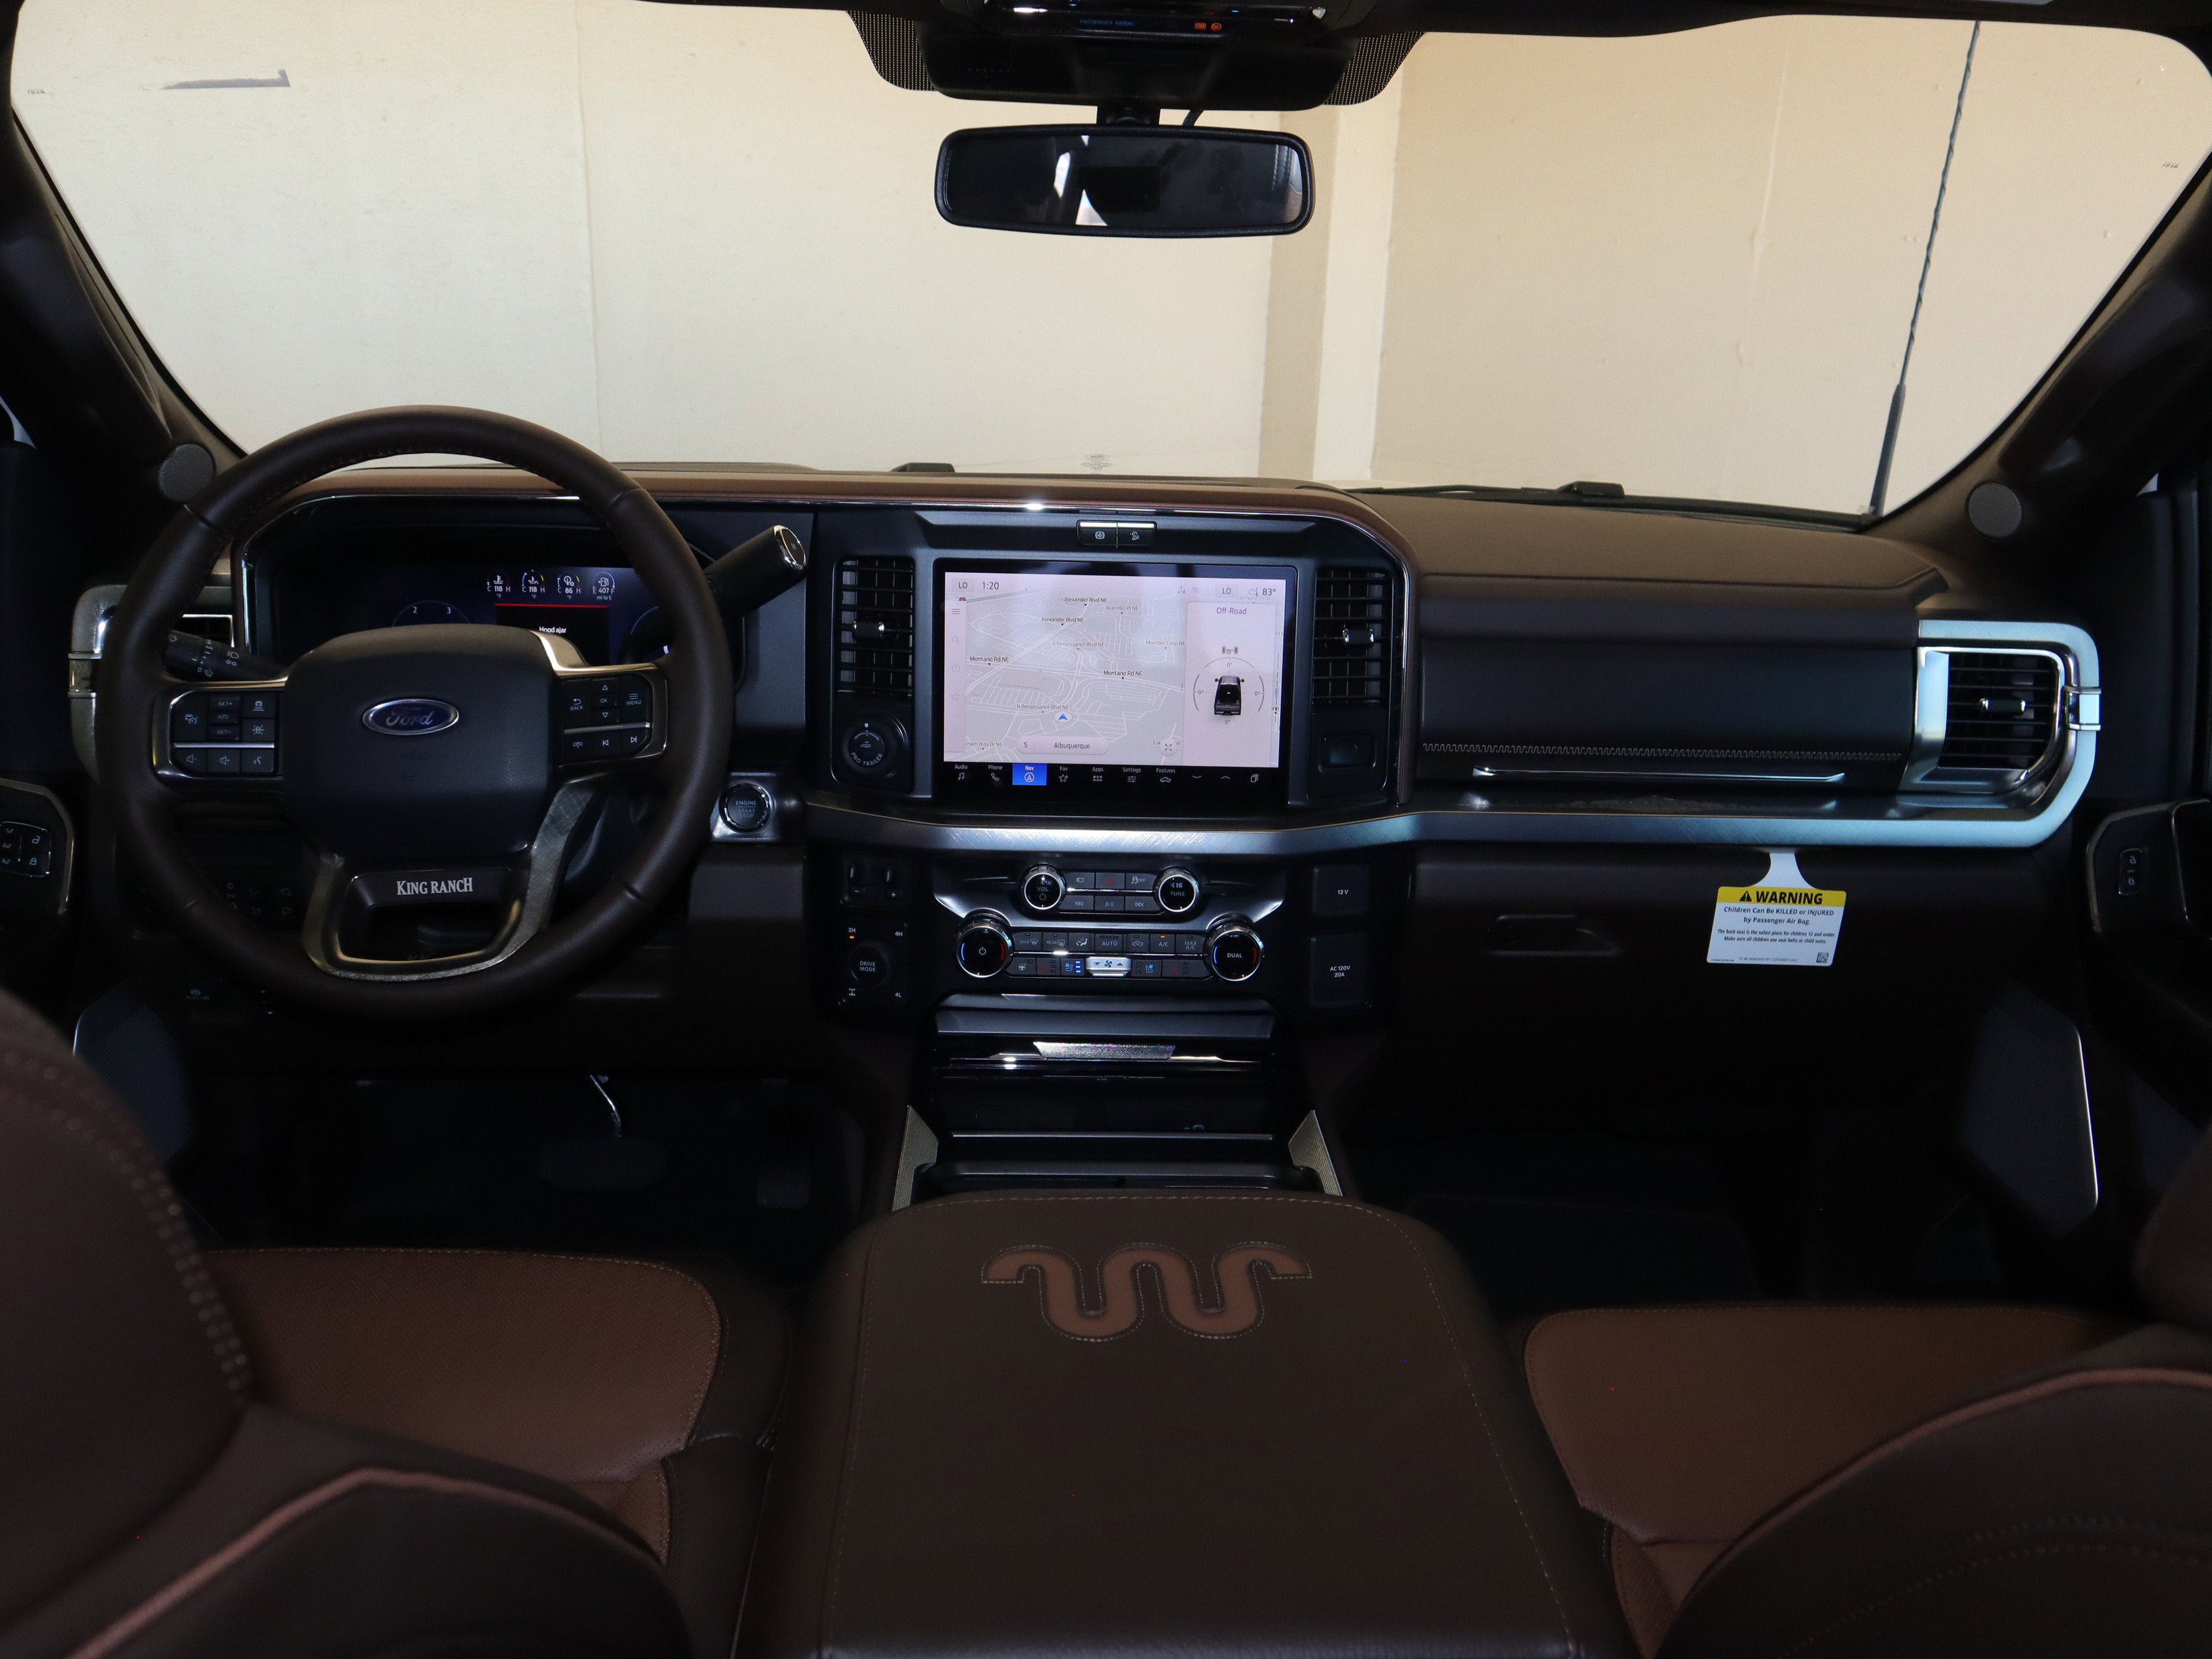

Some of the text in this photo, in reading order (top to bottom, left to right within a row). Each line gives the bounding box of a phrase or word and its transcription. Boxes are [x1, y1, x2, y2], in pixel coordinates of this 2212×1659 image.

[982, 582, 1000, 590] 1:20
[1262, 588, 1277, 596] 83°
[1216, 607, 1247, 615] Off-Road
[386, 707, 434, 726] Ford
[851, 752, 884, 766] PRO TRAILER
[397, 877, 473, 896] KING RANCH
[1756, 891, 1823, 905] WARNING
